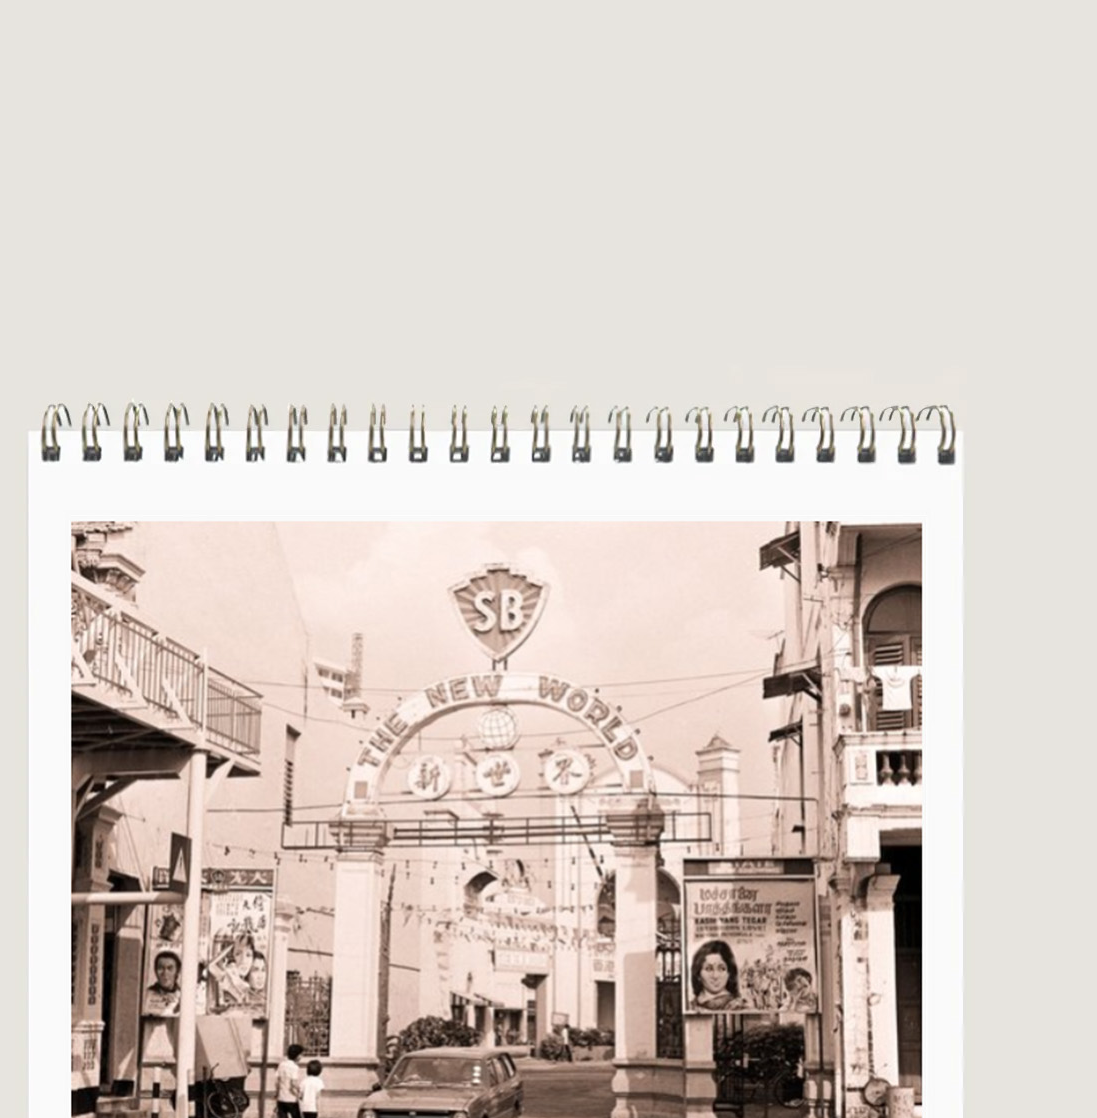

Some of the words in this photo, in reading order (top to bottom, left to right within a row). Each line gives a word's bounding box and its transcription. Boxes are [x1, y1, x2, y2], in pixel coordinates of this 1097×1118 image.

[473, 589, 525, 632] SB
[357, 712, 409, 768] THE
[424, 673, 504, 708] NEW
[538, 675, 639, 762] WORLD
